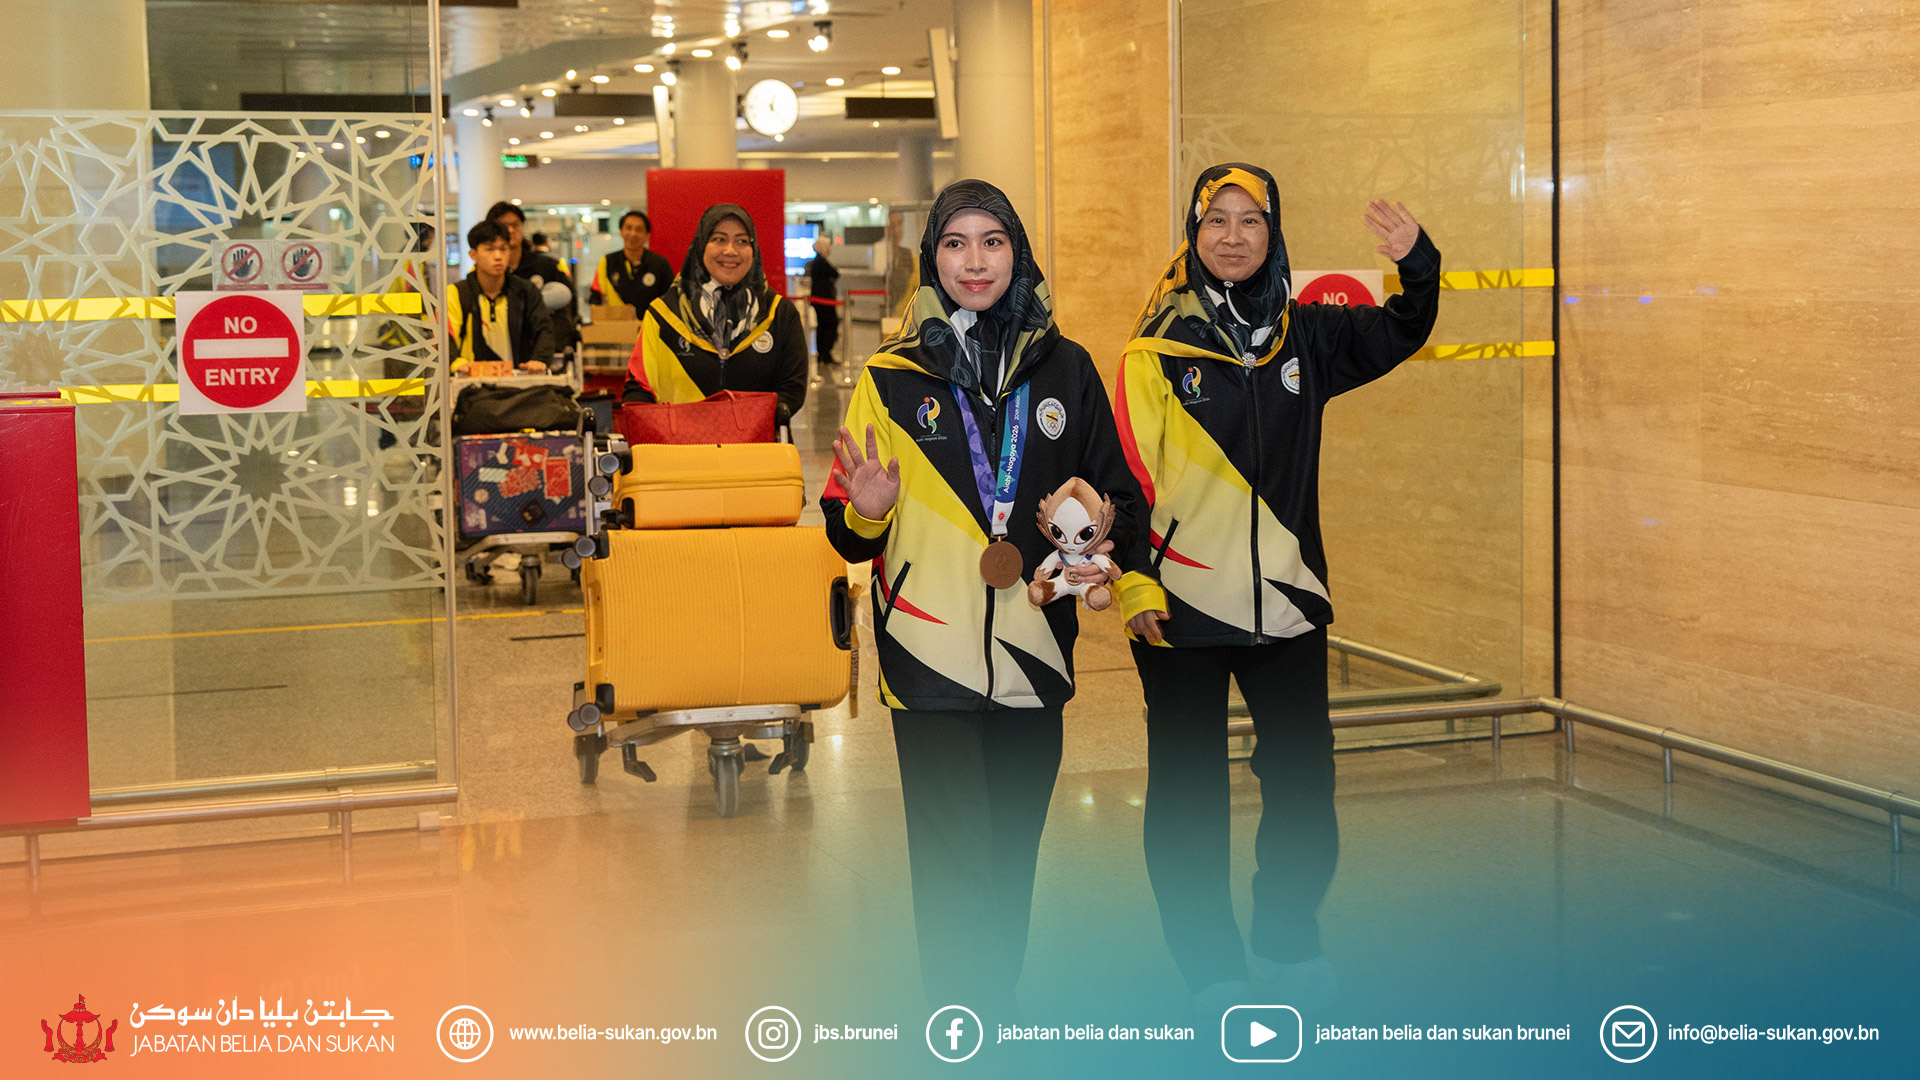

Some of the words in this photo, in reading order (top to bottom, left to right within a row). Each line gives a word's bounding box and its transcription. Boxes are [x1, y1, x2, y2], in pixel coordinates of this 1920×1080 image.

[1323, 292, 1348, 306] NO
[224, 316, 258, 334] NO
[205, 367, 280, 387] ENTRY
[1003, 443, 1017, 493] Aichi-Nagoya
[1010, 424, 1020, 443] 2026
